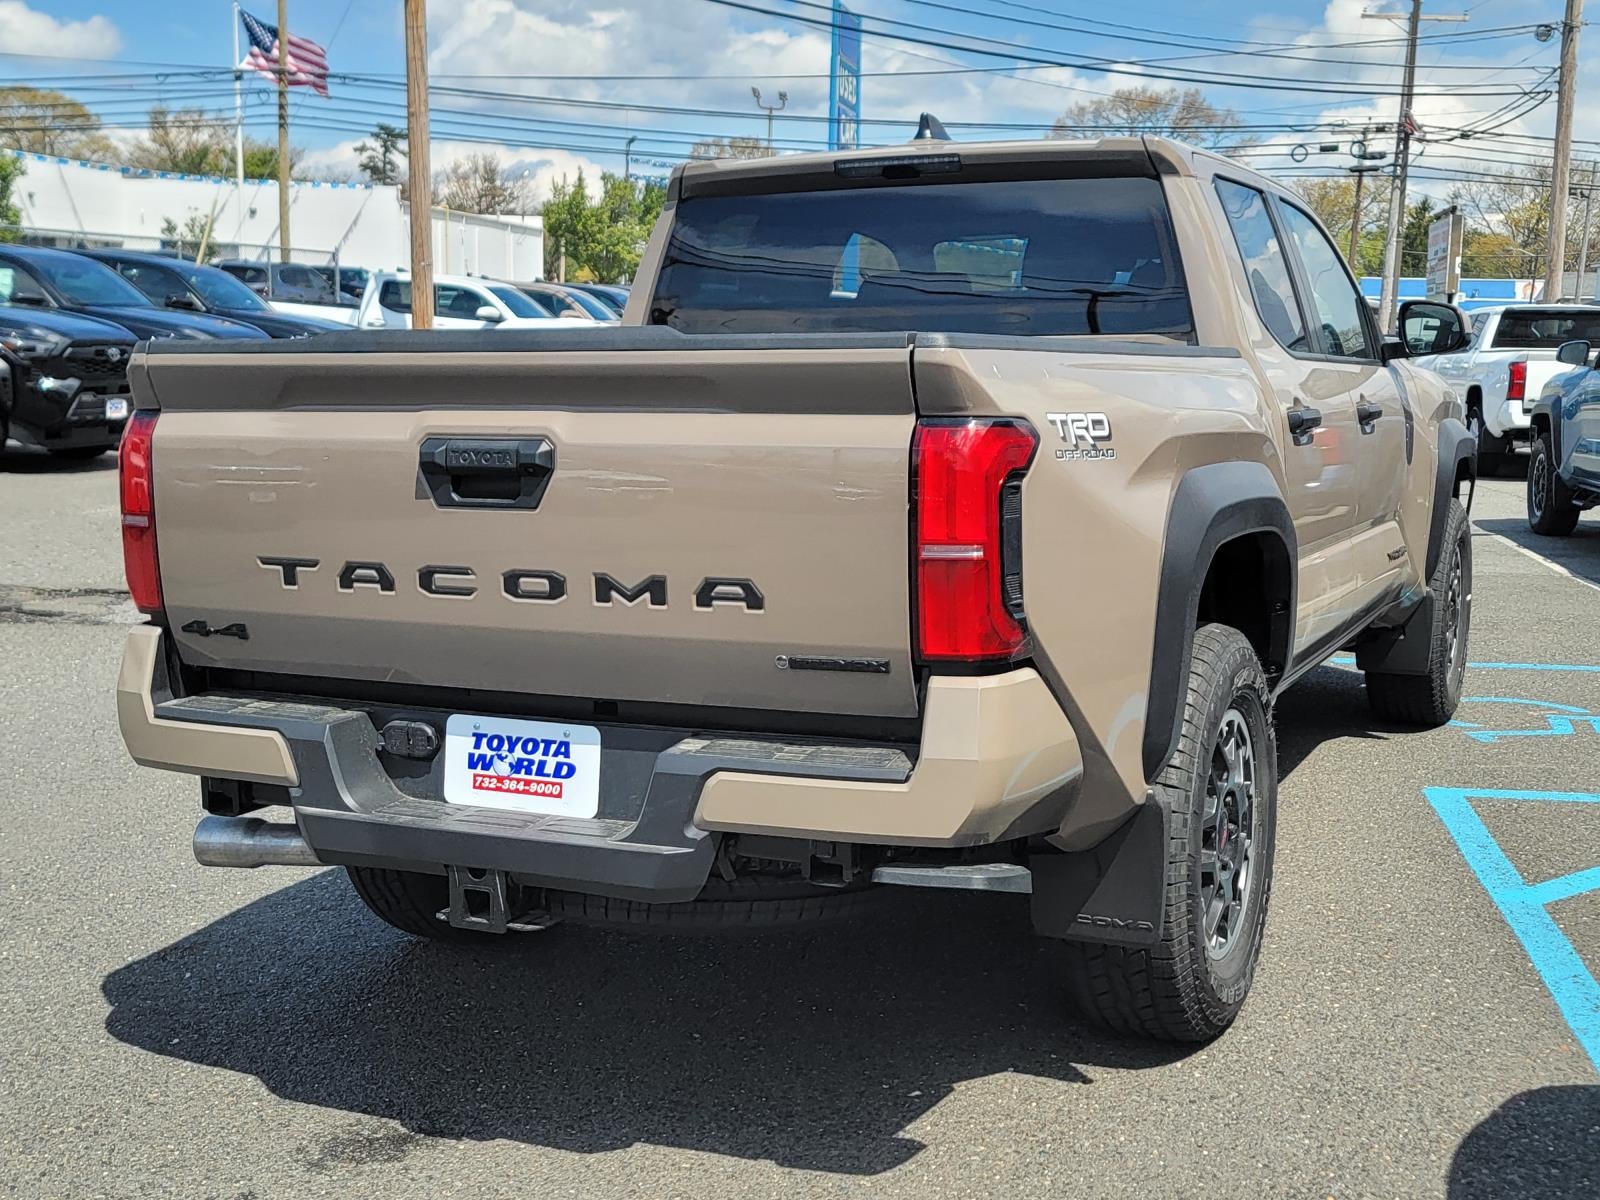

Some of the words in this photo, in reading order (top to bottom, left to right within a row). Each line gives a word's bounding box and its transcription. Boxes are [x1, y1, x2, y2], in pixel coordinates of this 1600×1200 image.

[840, 65, 857, 105] USED
[1046, 412, 1112, 447] TRD
[450, 450, 512, 465] TOYOTA
[1055, 448, 1081, 461] OFF
[1081, 448, 1117, 461] ROAD
[256, 555, 766, 614] TACOMA
[472, 732, 571, 759] TOYOTA
[467, 752, 577, 779] WORLD
[474, 776, 561, 795] 732-364-9000
